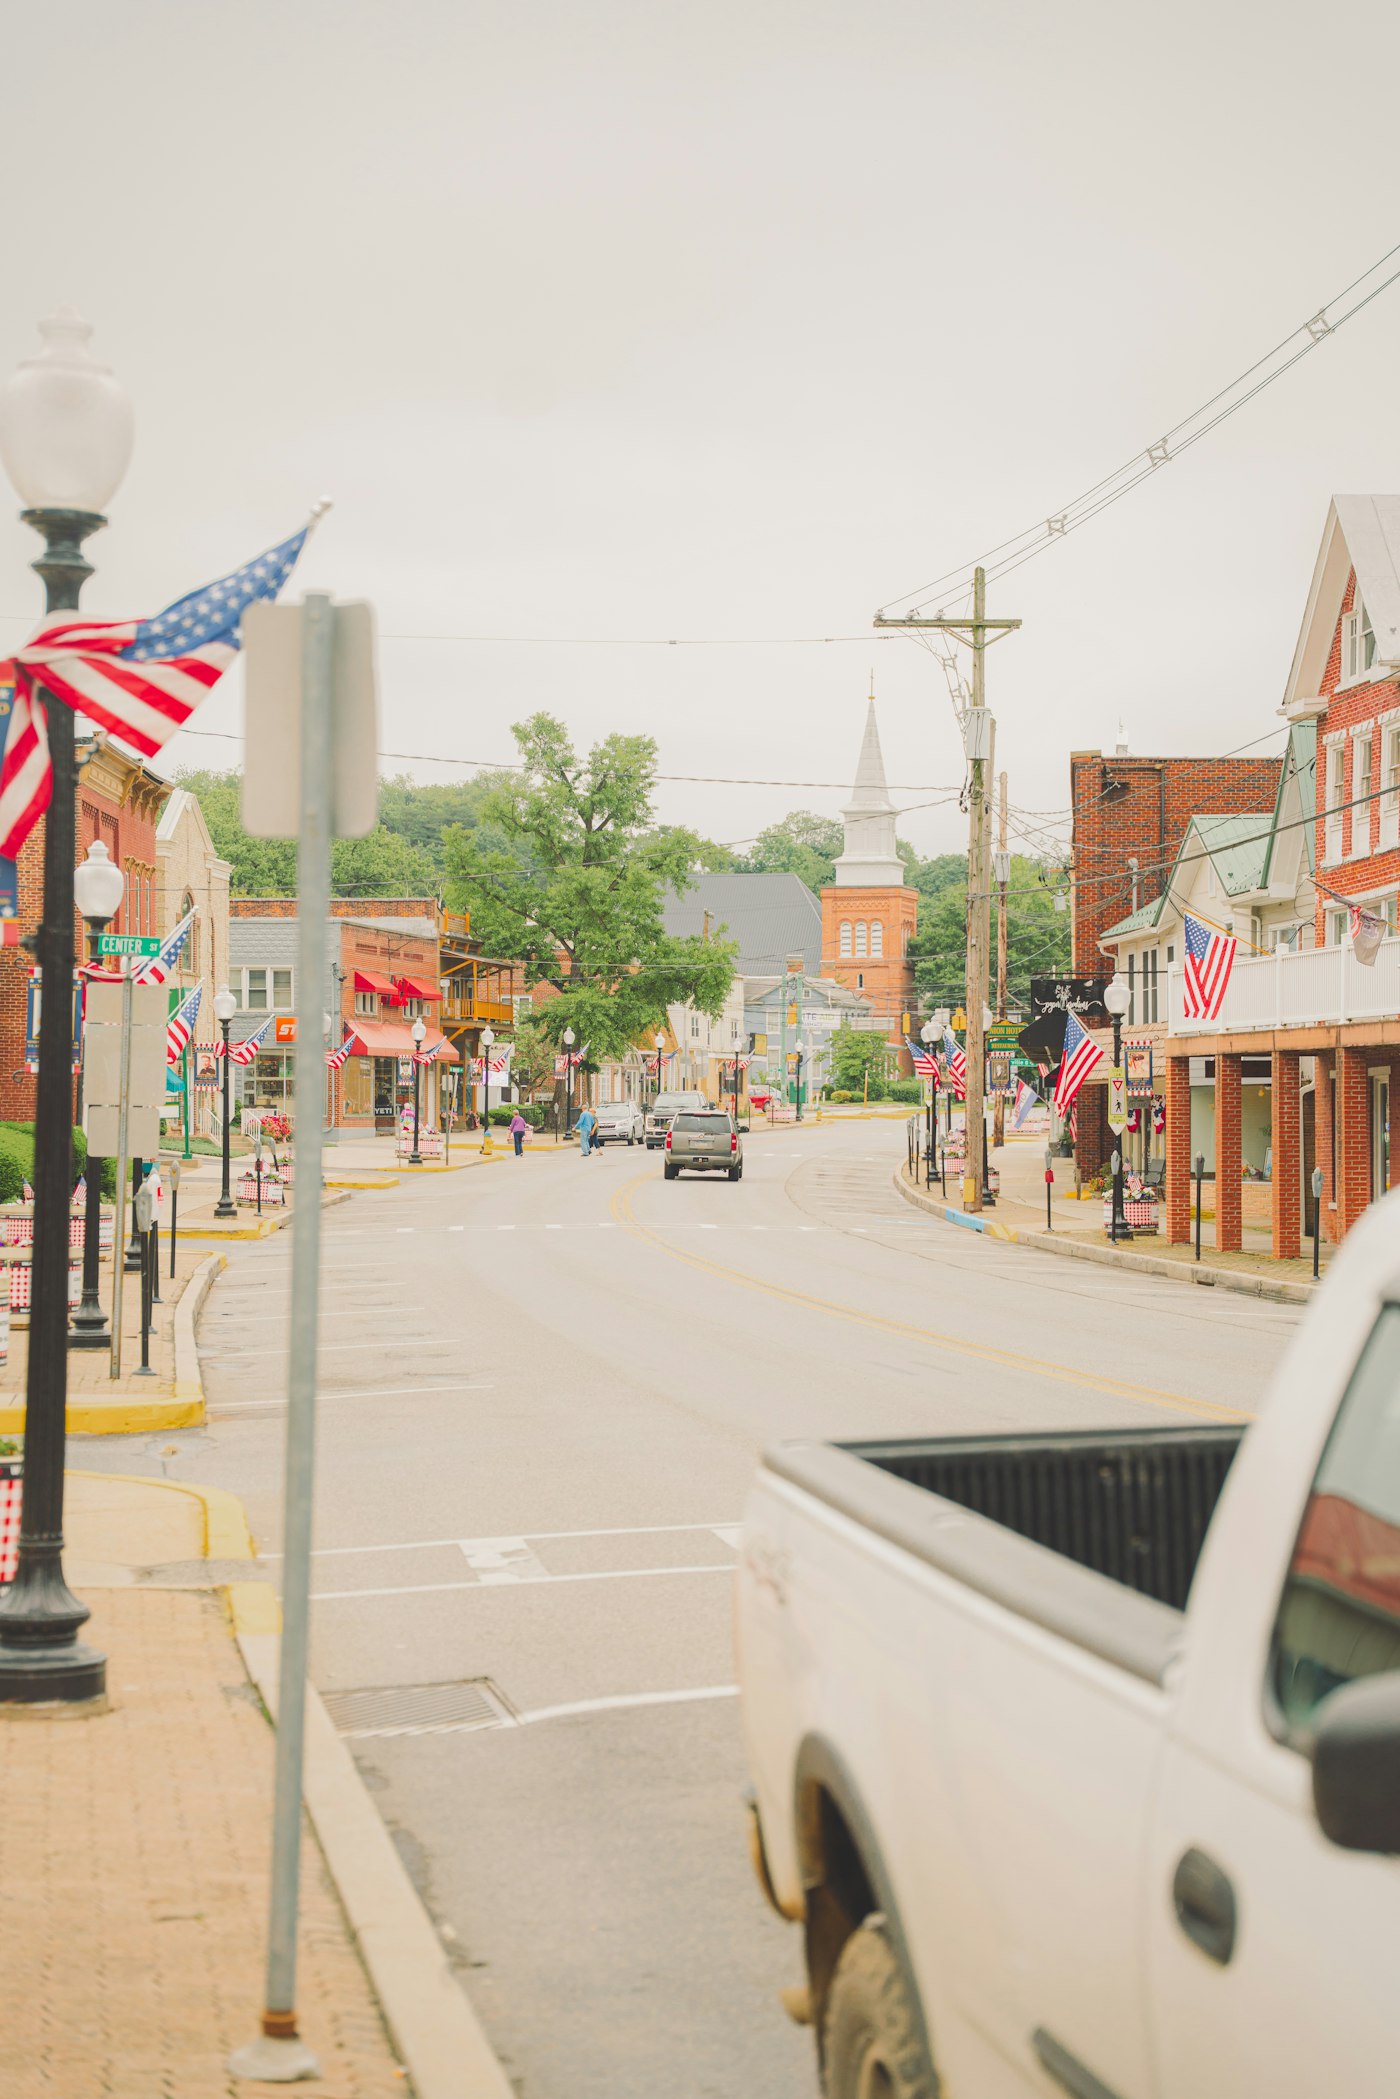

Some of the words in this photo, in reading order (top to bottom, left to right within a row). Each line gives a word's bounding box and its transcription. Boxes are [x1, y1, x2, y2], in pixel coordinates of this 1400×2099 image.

[101, 936, 143, 954] CENTER
[149, 943, 158, 952] ST
[375, 1107, 392, 1115] YETI
